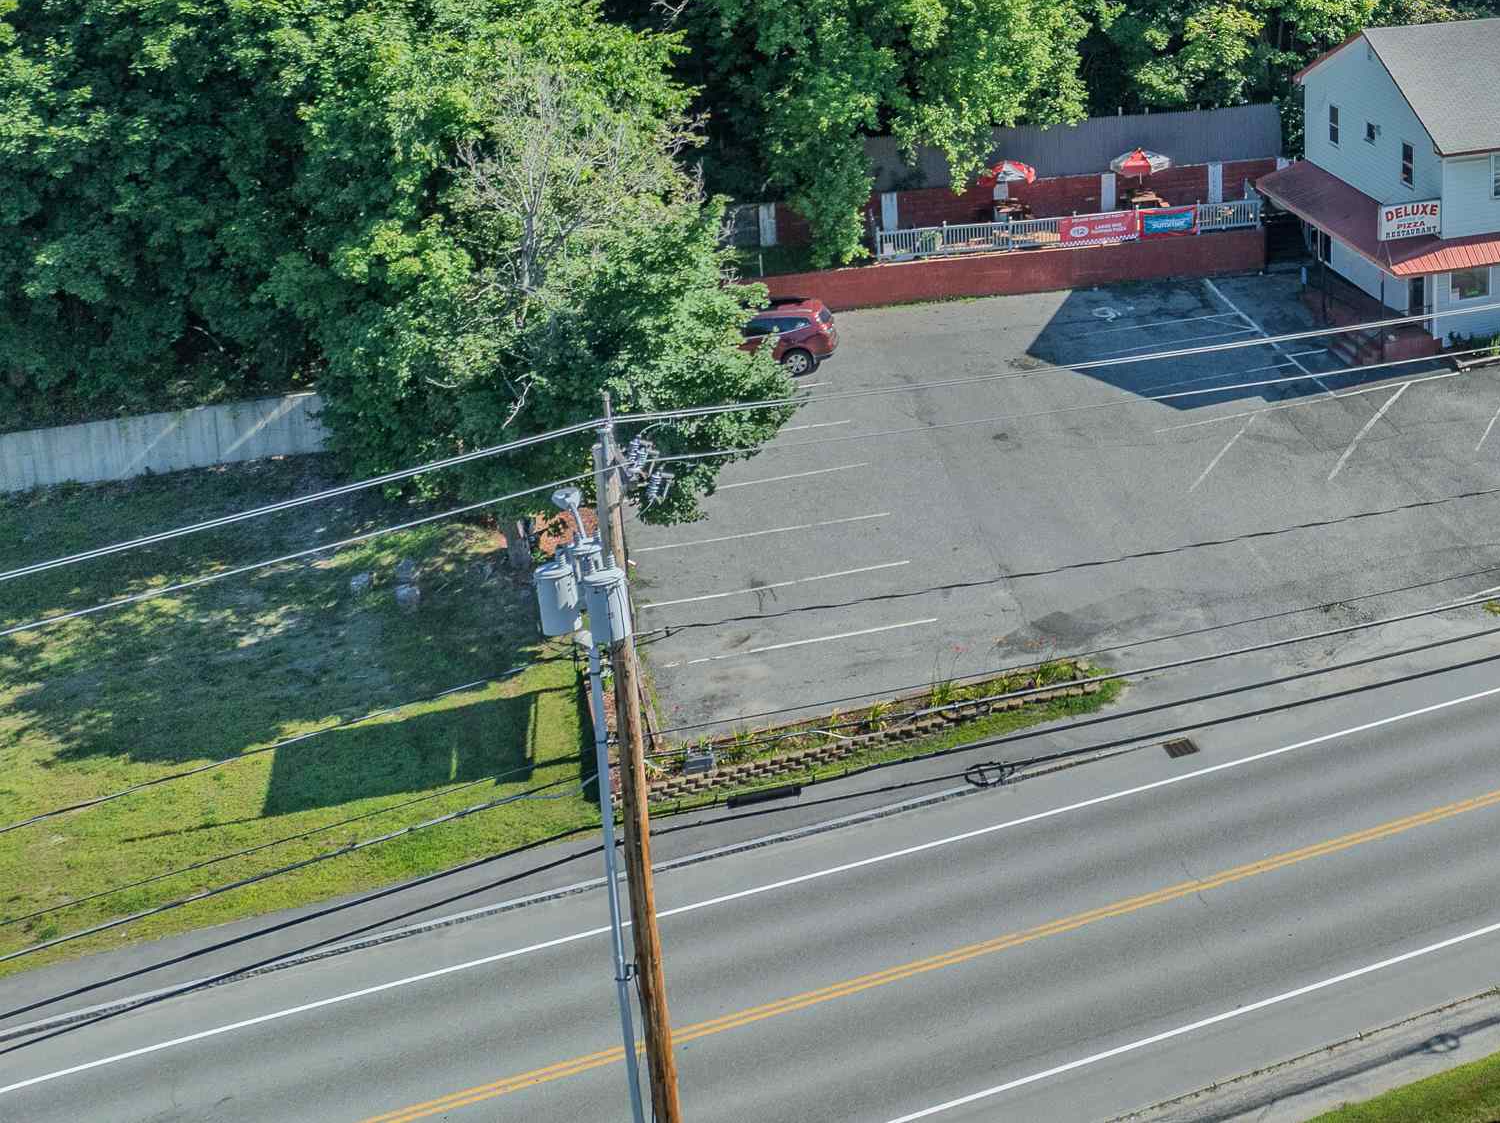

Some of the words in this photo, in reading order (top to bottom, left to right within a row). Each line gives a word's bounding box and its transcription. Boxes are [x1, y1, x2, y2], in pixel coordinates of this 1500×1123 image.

[1385, 204, 1438, 222] DELUXE
[1397, 221, 1425, 229] PIZZA
[1386, 226, 1437, 238] RESTAURANT
